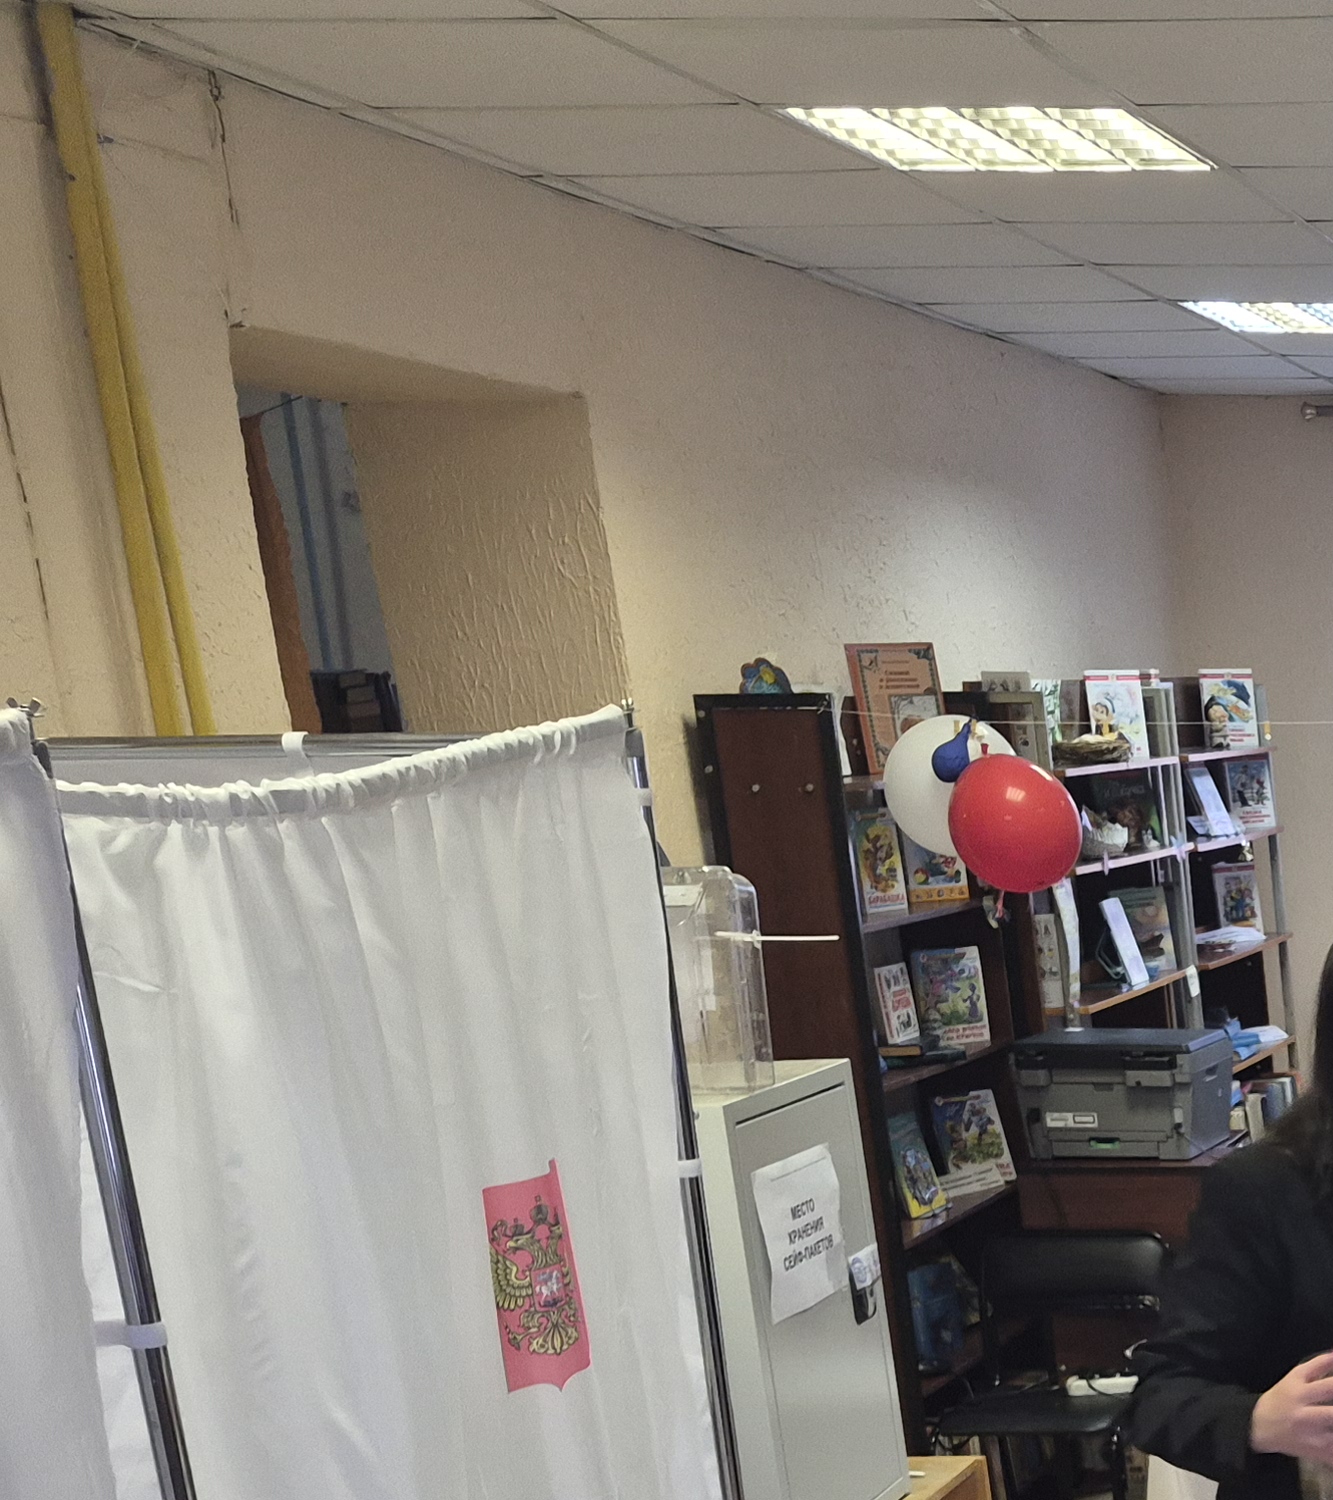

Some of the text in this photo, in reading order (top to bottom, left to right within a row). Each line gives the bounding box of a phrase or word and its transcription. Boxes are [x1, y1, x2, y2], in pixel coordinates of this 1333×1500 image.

[791, 1198, 816, 1221] МЕСТО
[787, 1216, 825, 1246] ХРАНЕНИЯ
[783, 1234, 835, 1272] СЕЙФ-ПАКЕТОВ
